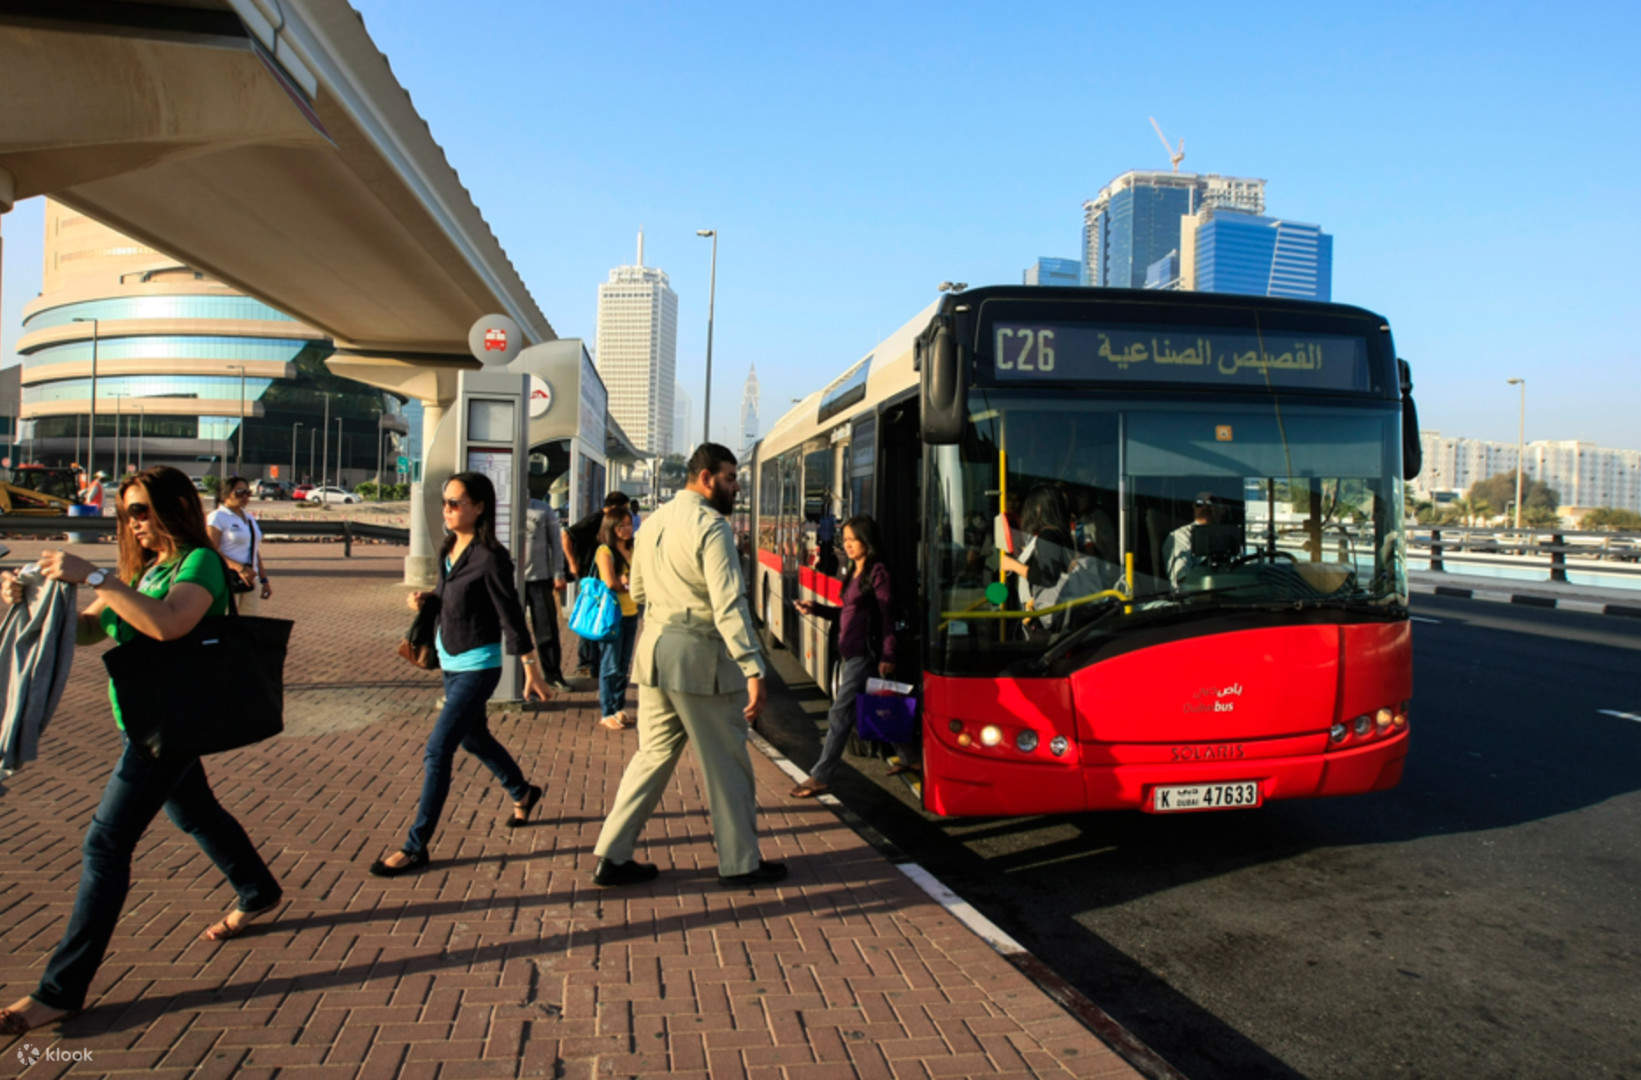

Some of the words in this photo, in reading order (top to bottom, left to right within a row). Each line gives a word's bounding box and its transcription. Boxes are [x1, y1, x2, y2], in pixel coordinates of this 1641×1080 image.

[997, 328, 1055, 371] C26
[1098, 333, 1211, 369] الصناعية
[1217, 343, 1322, 374] القصيص
[1171, 745, 1245, 761] SOLARIS
[1161, 790, 1170, 808] K
[1203, 784, 1254, 806] 47633
